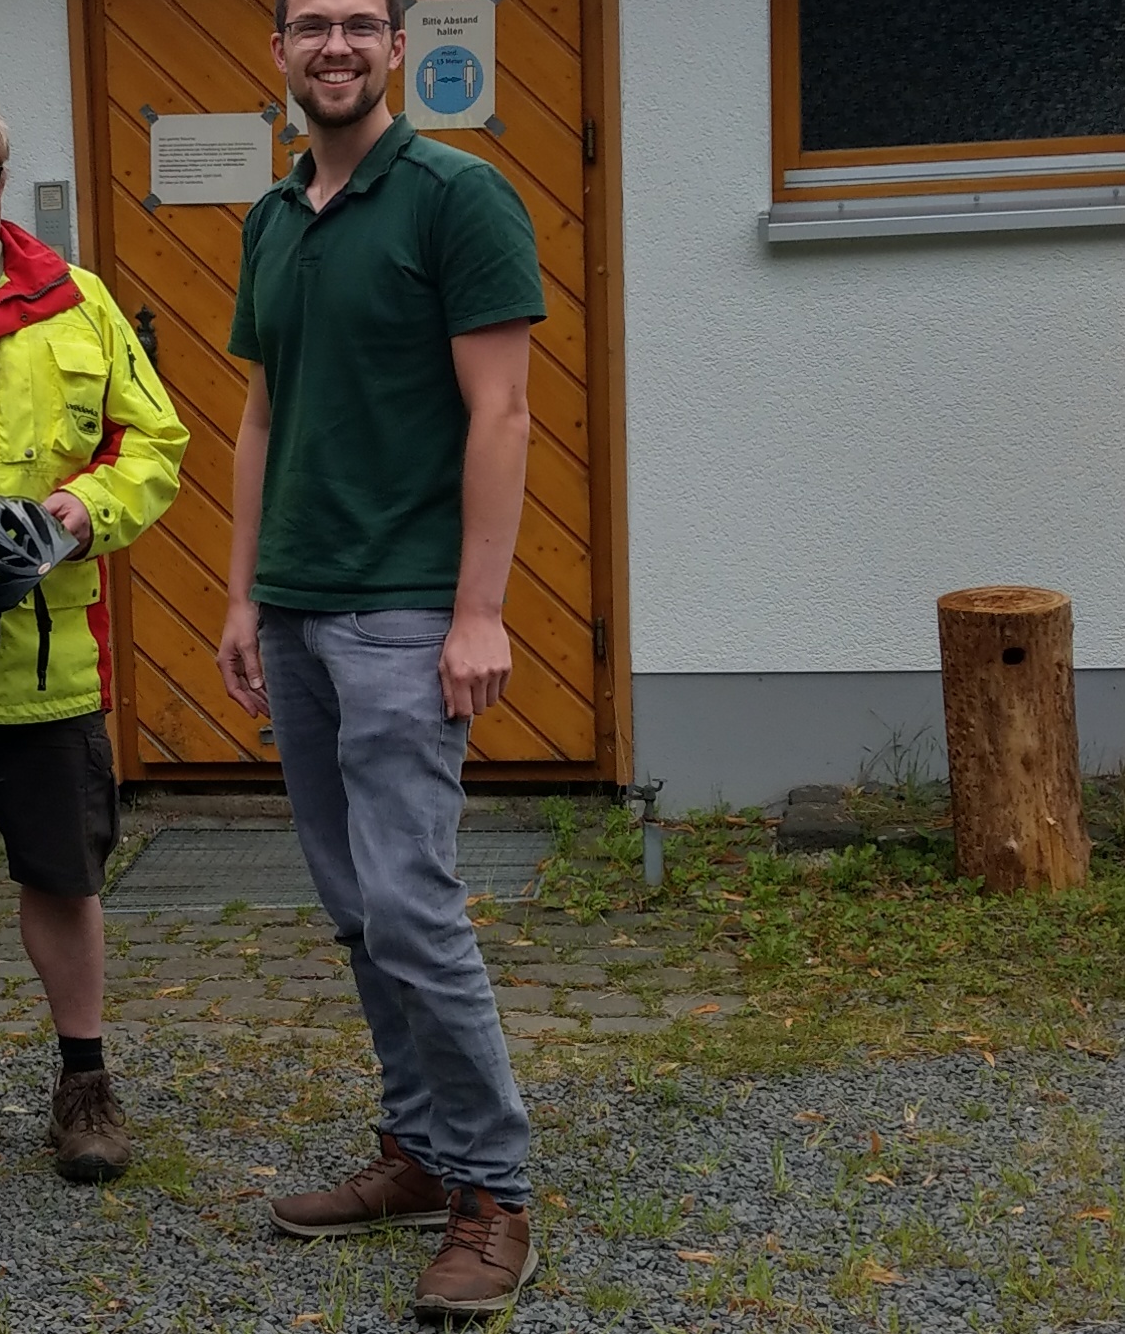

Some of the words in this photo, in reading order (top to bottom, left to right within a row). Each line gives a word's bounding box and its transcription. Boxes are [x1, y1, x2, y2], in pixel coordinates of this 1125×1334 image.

[422, 17, 441, 26] Bitte
[444, 15, 478, 25] Abstand
[437, 27, 463, 36] halten
